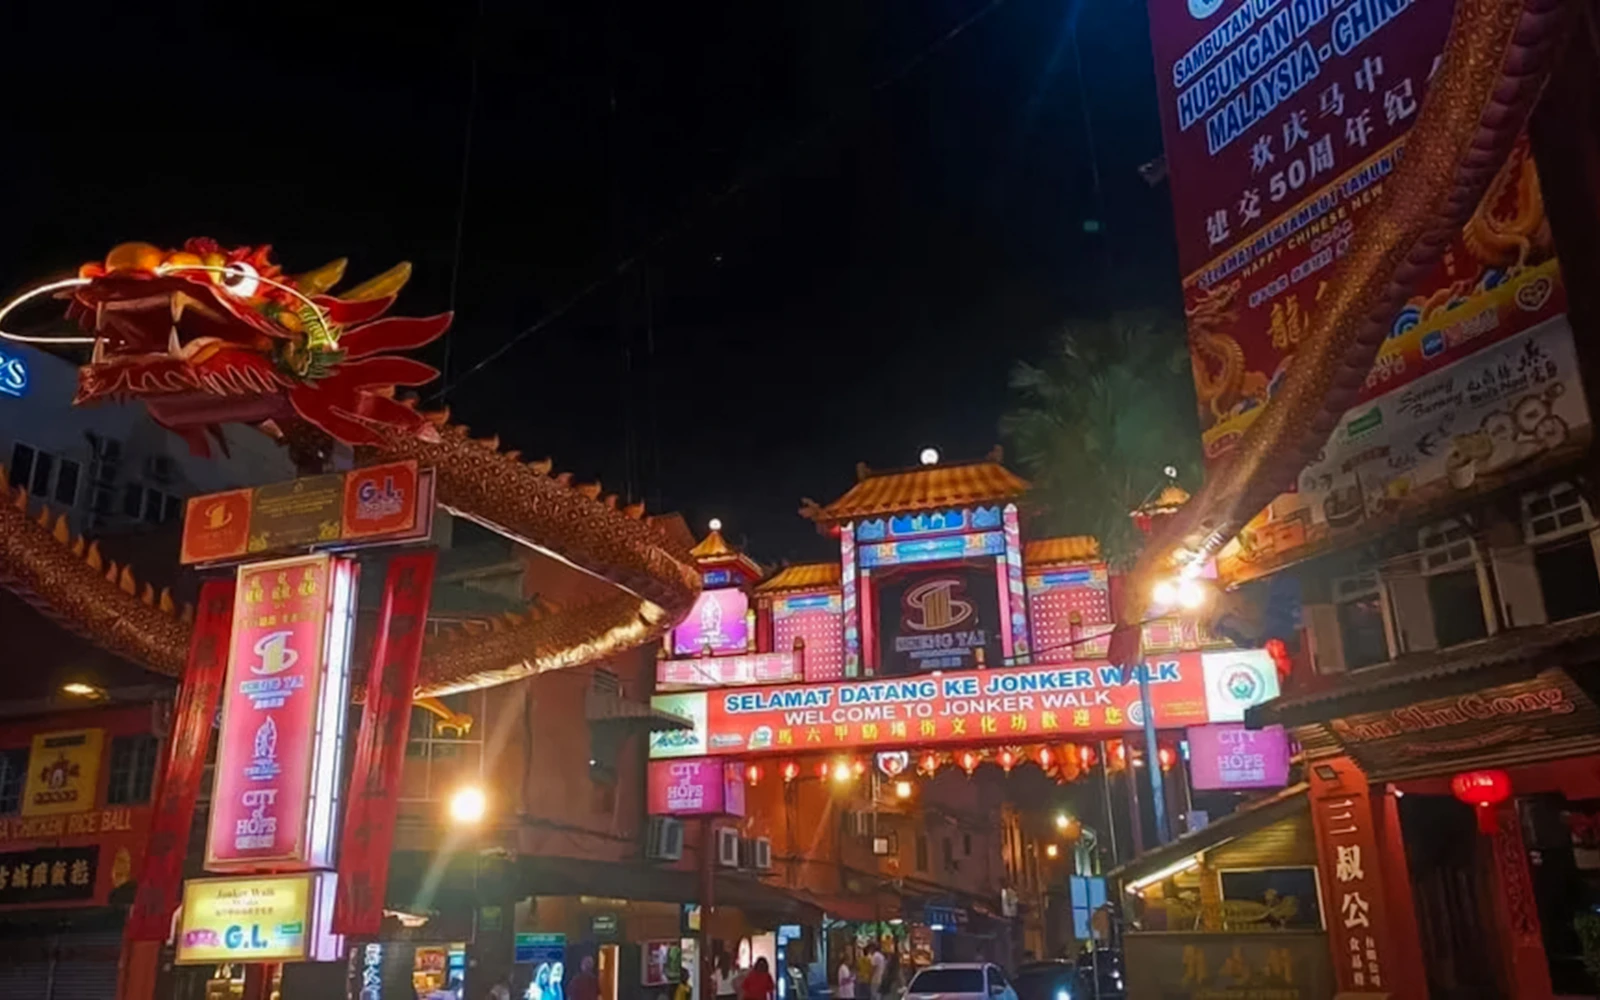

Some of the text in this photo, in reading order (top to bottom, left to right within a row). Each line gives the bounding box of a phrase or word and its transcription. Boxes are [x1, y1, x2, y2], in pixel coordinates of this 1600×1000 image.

[1174, 1, 1255, 87] SAMBUTAN
[1177, 7, 1293, 131] HUBUNGAN
[1206, 41, 1318, 155] MALAYSIA
[1331, 0, 1416, 56] CHIN
[1242, 246, 1284, 280] HAPPY
[1287, 206, 1347, 250] CHINESE
[1350, 183, 1384, 212] NEW
[725, 688, 832, 714] SELAMAT
[839, 681, 937, 705] DATANG
[944, 677, 980, 698] KE
[985, 670, 1094, 695] JONKER
[784, 690, 1113, 726] WELCOME TO JONKER WALK
[1458, 688, 1575, 720] Gong
[68, 811, 97, 834] RICE
[101, 807, 132, 831] BALL
[1328, 799, 1370, 929] 三叔公
[225, 924, 268, 949] G.L.
